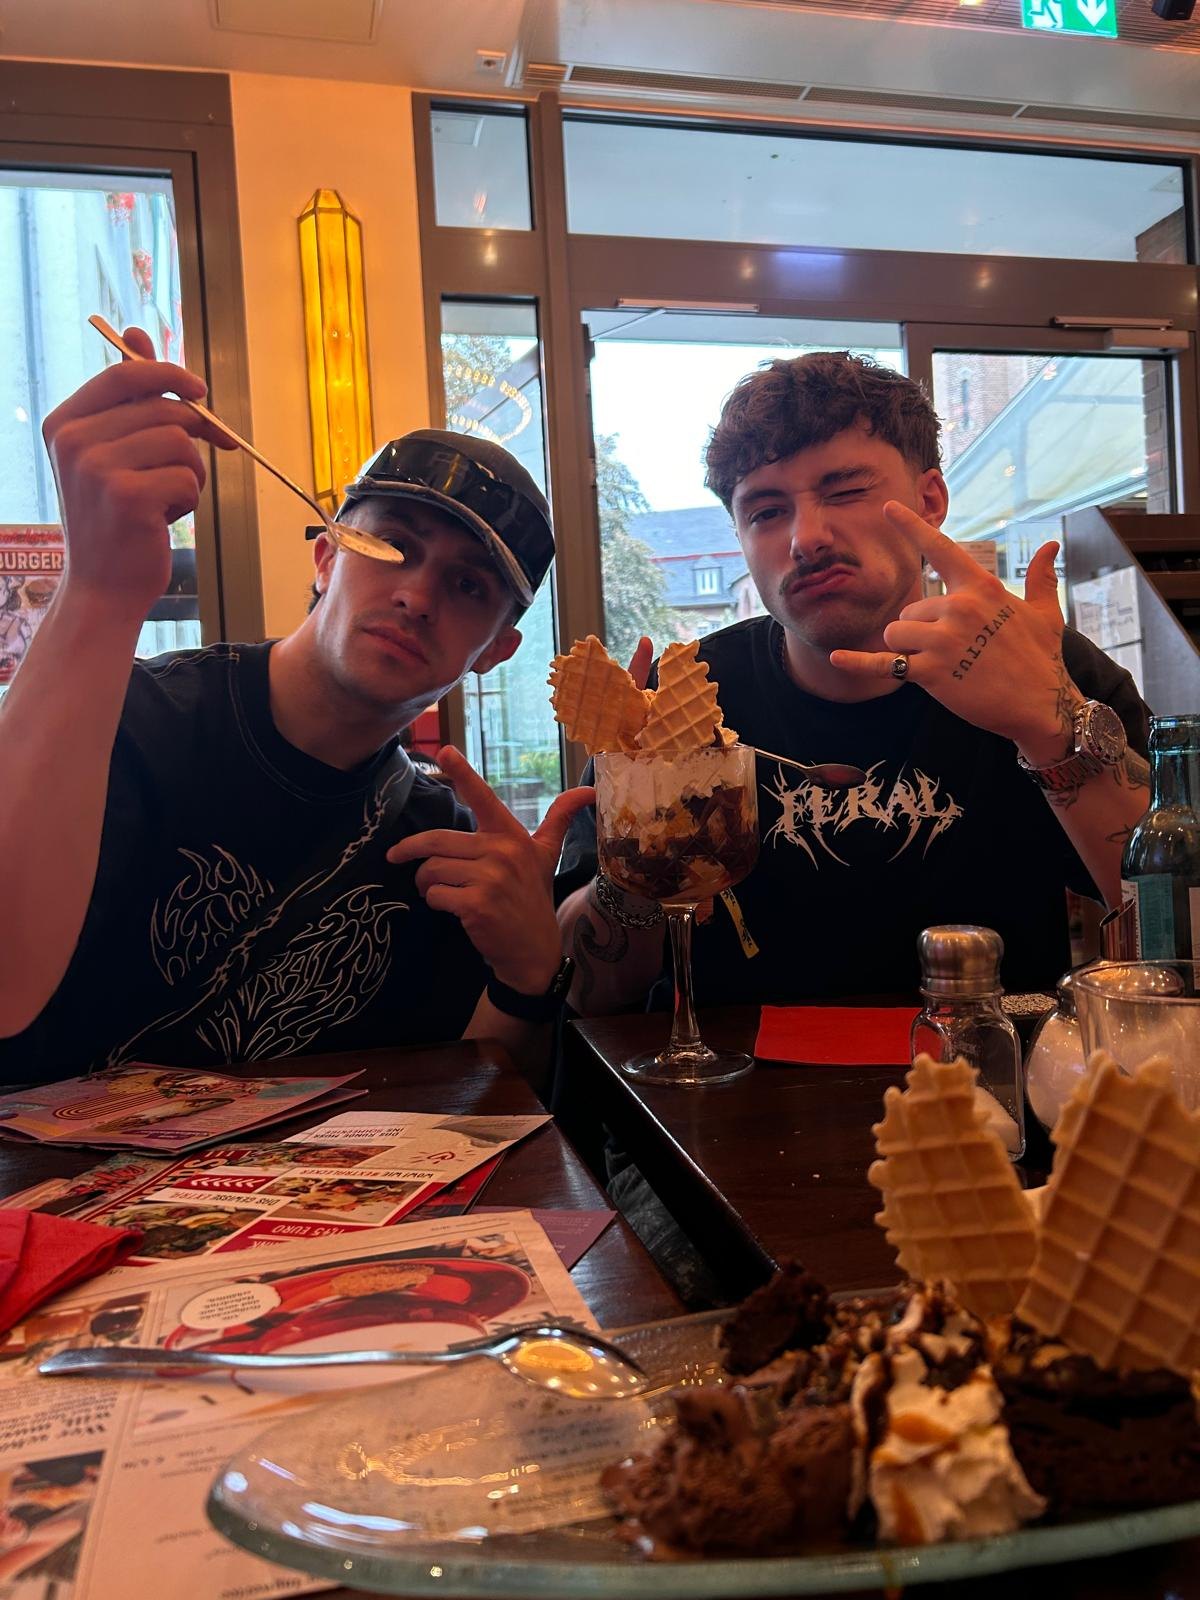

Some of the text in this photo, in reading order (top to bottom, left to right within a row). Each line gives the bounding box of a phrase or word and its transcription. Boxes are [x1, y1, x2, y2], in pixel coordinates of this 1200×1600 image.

[952, 605, 1015, 680] INVICTUS
[255, 1198, 281, 1206] DAS
[271, 1224, 312, 1235] EURO
